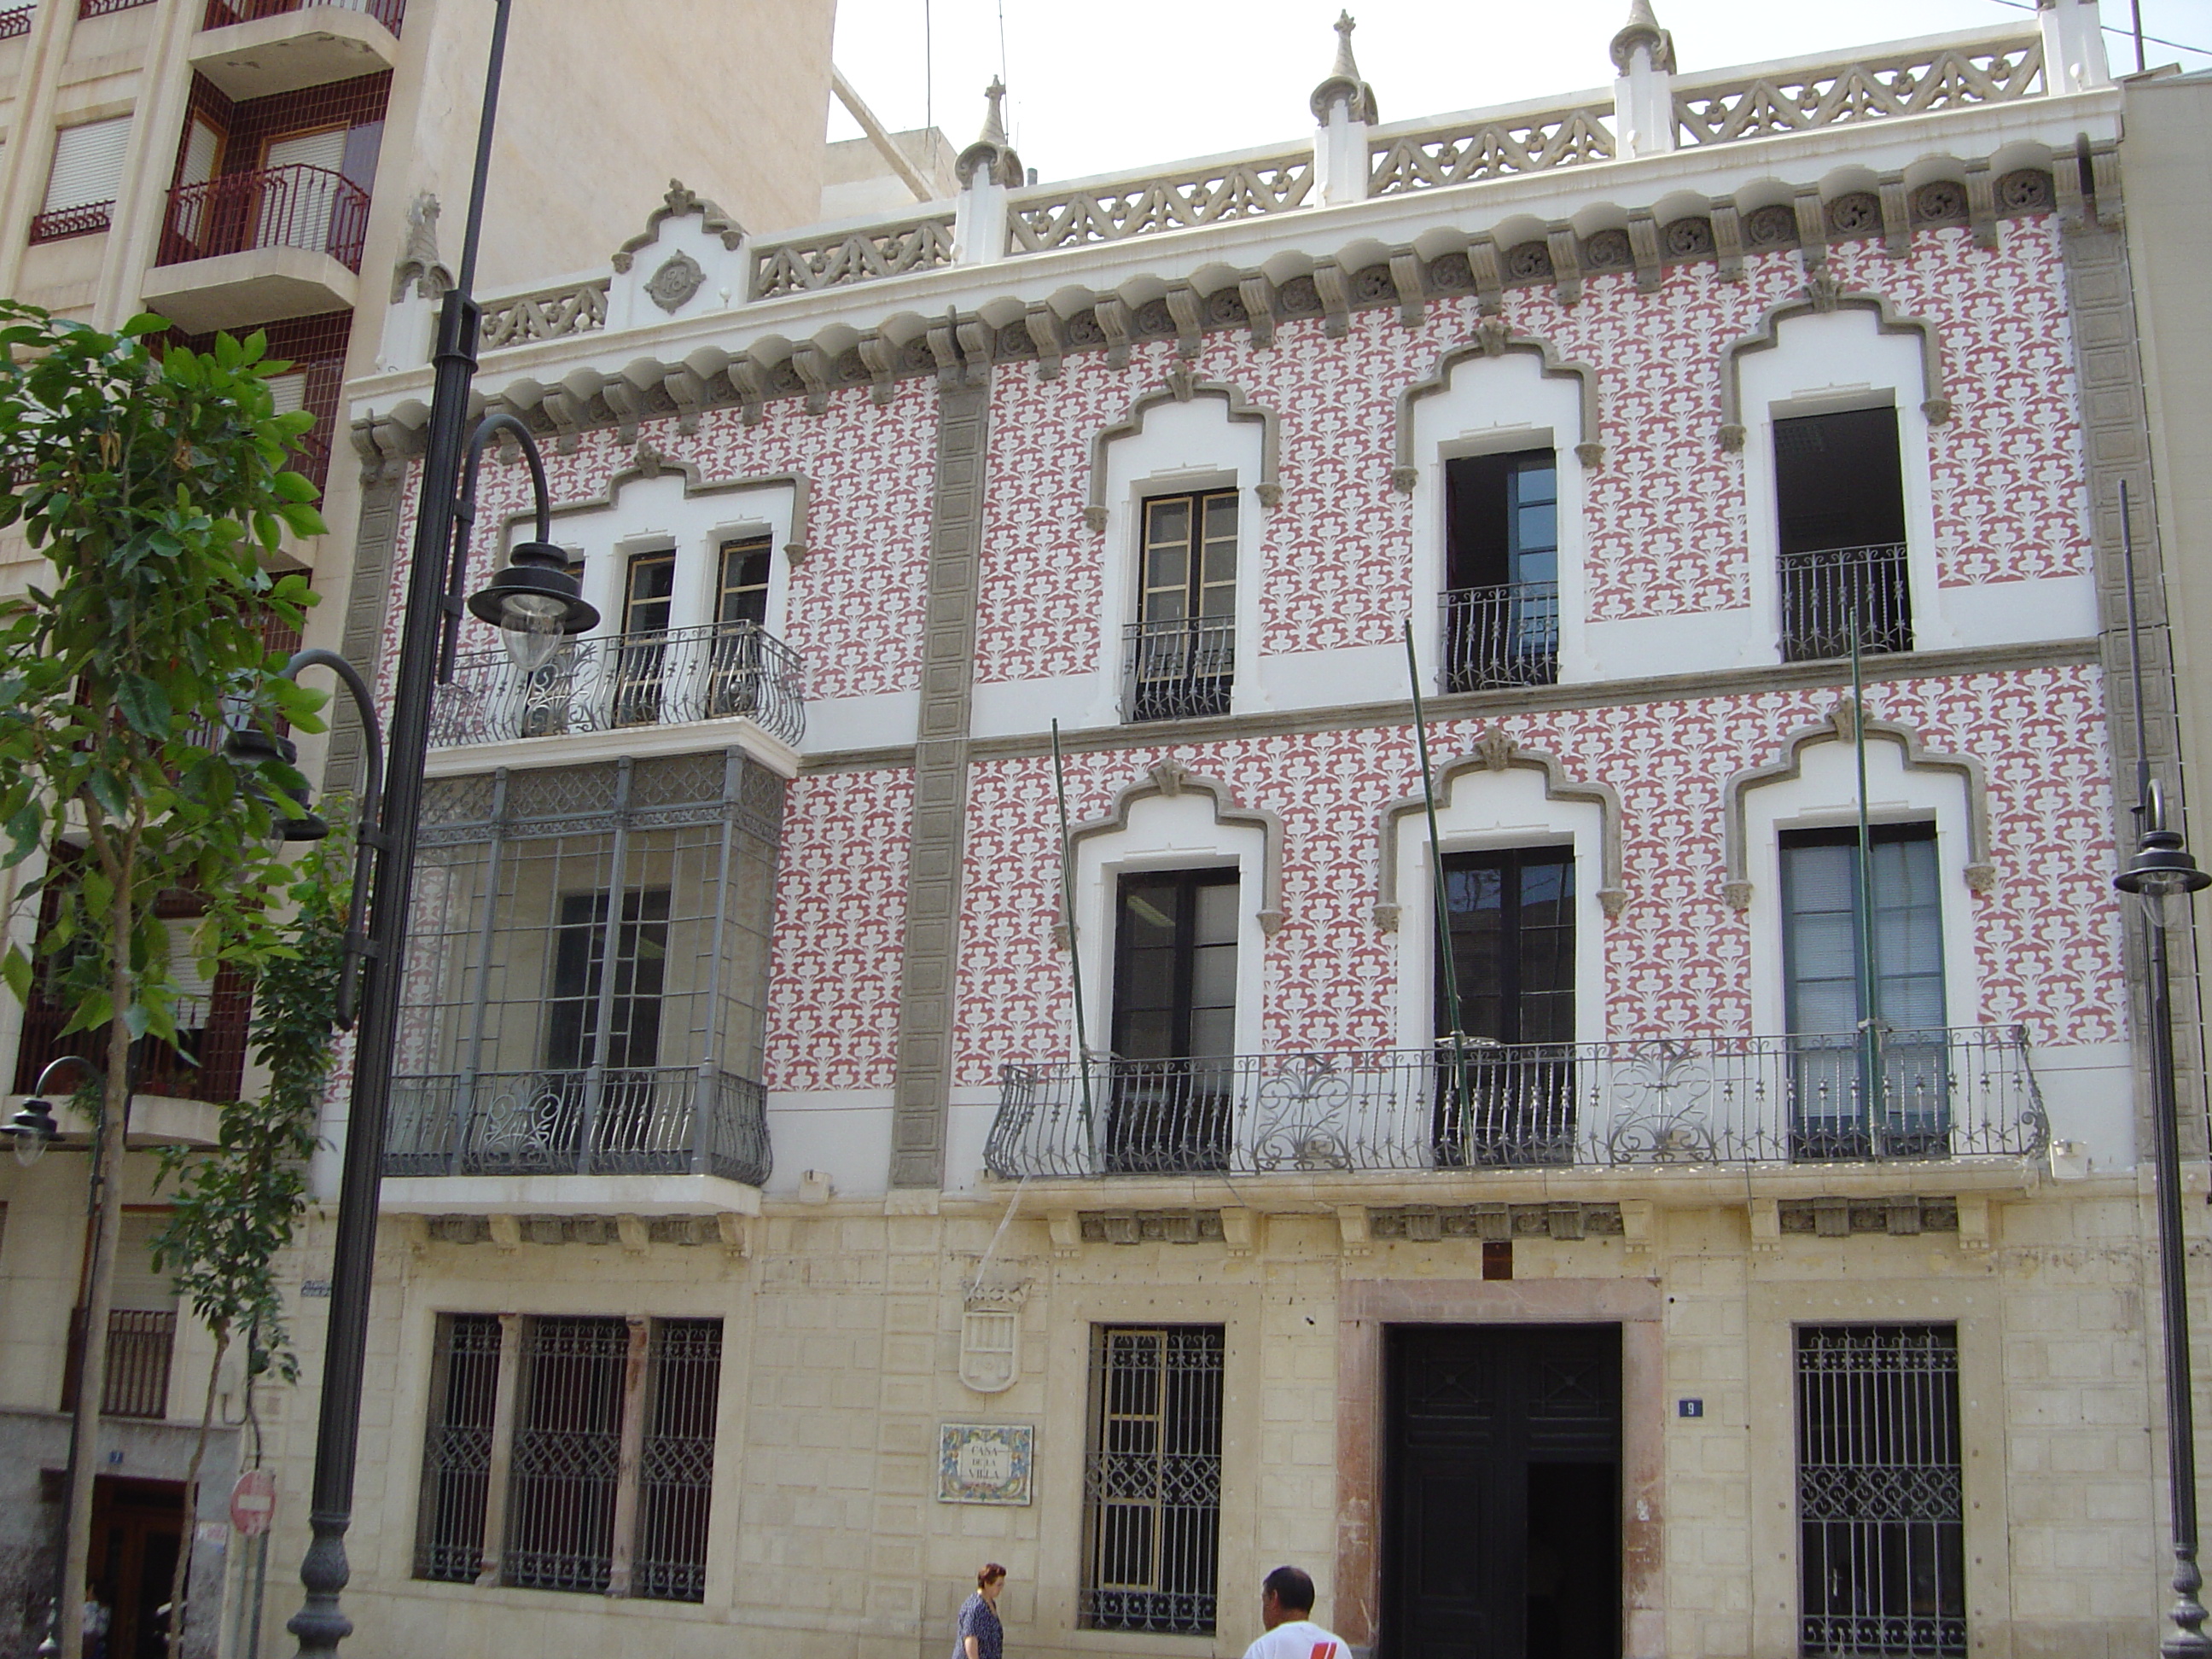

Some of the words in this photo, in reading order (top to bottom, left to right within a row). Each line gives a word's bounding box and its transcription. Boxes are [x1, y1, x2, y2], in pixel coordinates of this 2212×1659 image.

[1687, 1402, 1695, 1415] 9
[971, 1446, 998, 1457] CASA
[986, 1458, 996, 1467] LA
[969, 1469, 999, 1480] VILLA
